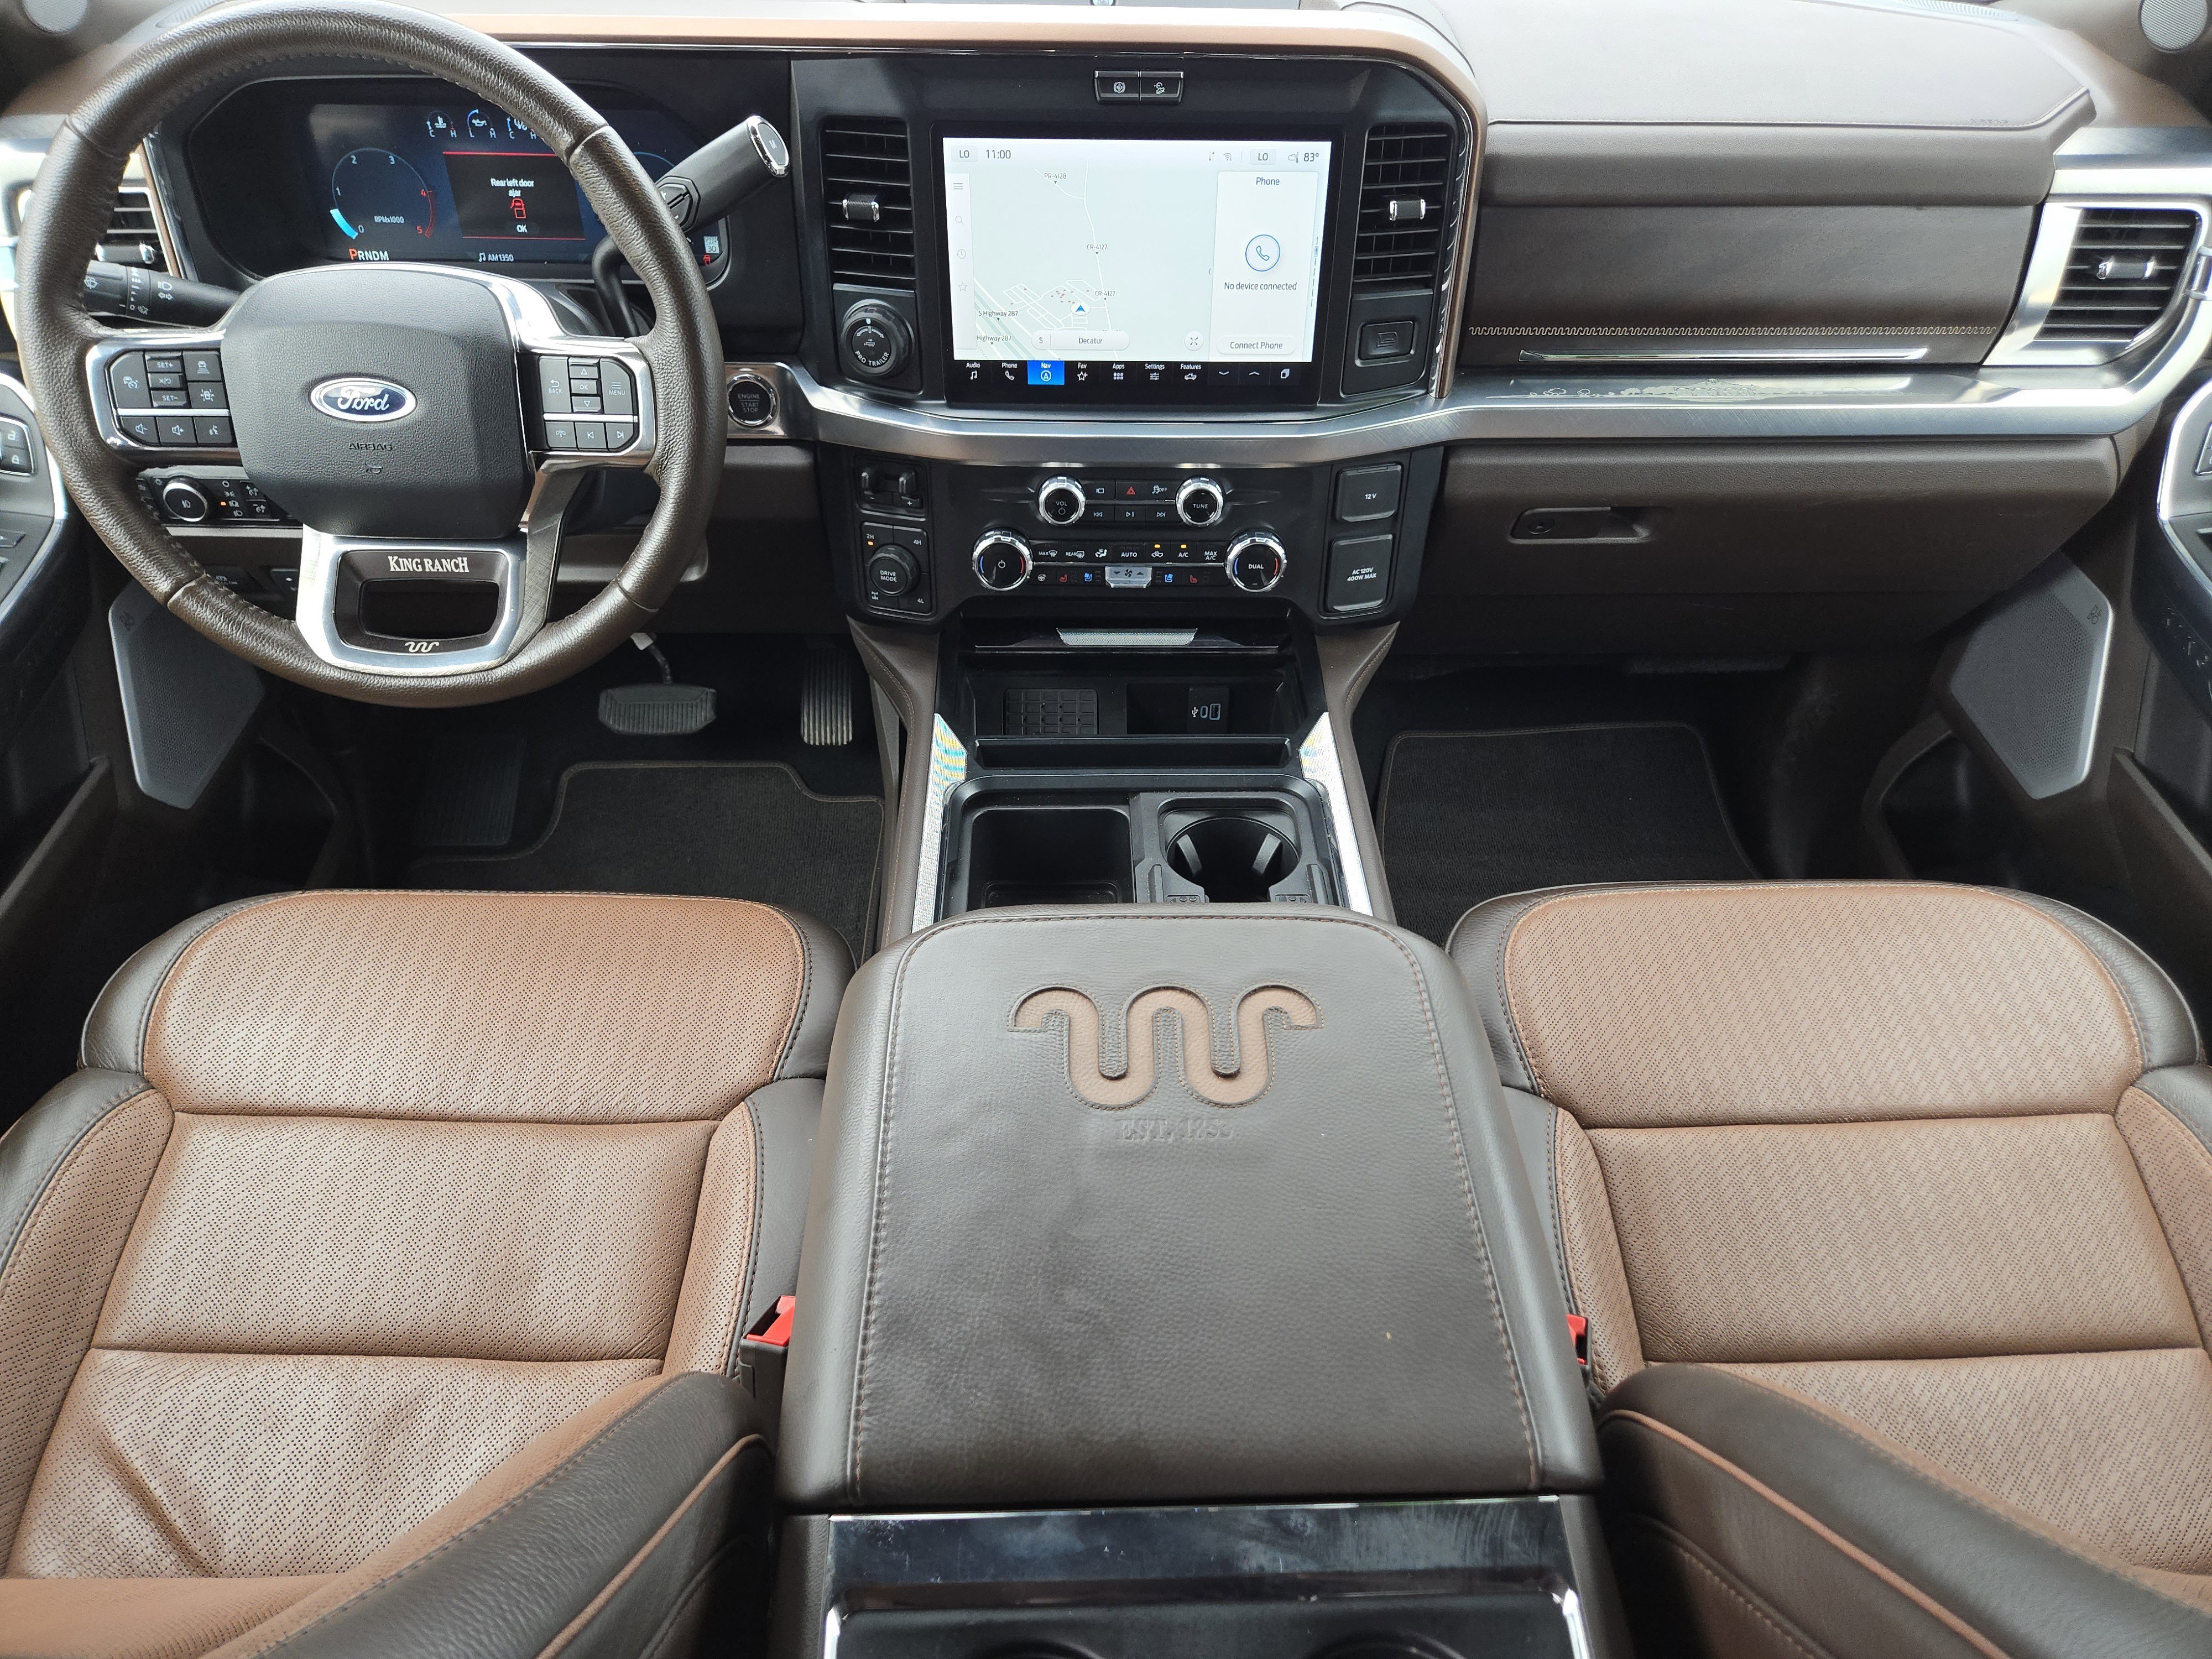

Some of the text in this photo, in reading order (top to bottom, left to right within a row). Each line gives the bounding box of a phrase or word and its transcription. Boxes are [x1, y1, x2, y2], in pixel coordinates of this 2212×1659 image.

[450, 129, 457, 138] H
[489, 129, 496, 138] H
[959, 149, 969, 158] LO
[985, 149, 1011, 159] 11:00
[1258, 153, 1268, 161] LO
[1303, 152, 1319, 161] 83°
[351, 155, 357, 164] 2
[389, 155, 395, 164] 3
[491, 178, 534, 187] Rear left door
[1256, 176, 1280, 185] Phone
[336, 186, 341, 195] 1
[420, 189, 426, 197] 4
[508, 189, 521, 197] ajar
[358, 225, 364, 233] 0
[416, 225, 422, 234] 5
[516, 224, 527, 233] OK
[1235, 282, 1259, 290] device
[1230, 341, 1283, 349] Connect Phone
[854, 351, 890, 366] PRO TRAILER
[337, 385, 389, 411] Ford
[348, 442, 393, 451] AIRBAG
[388, 556, 469, 573] KING RANCH
